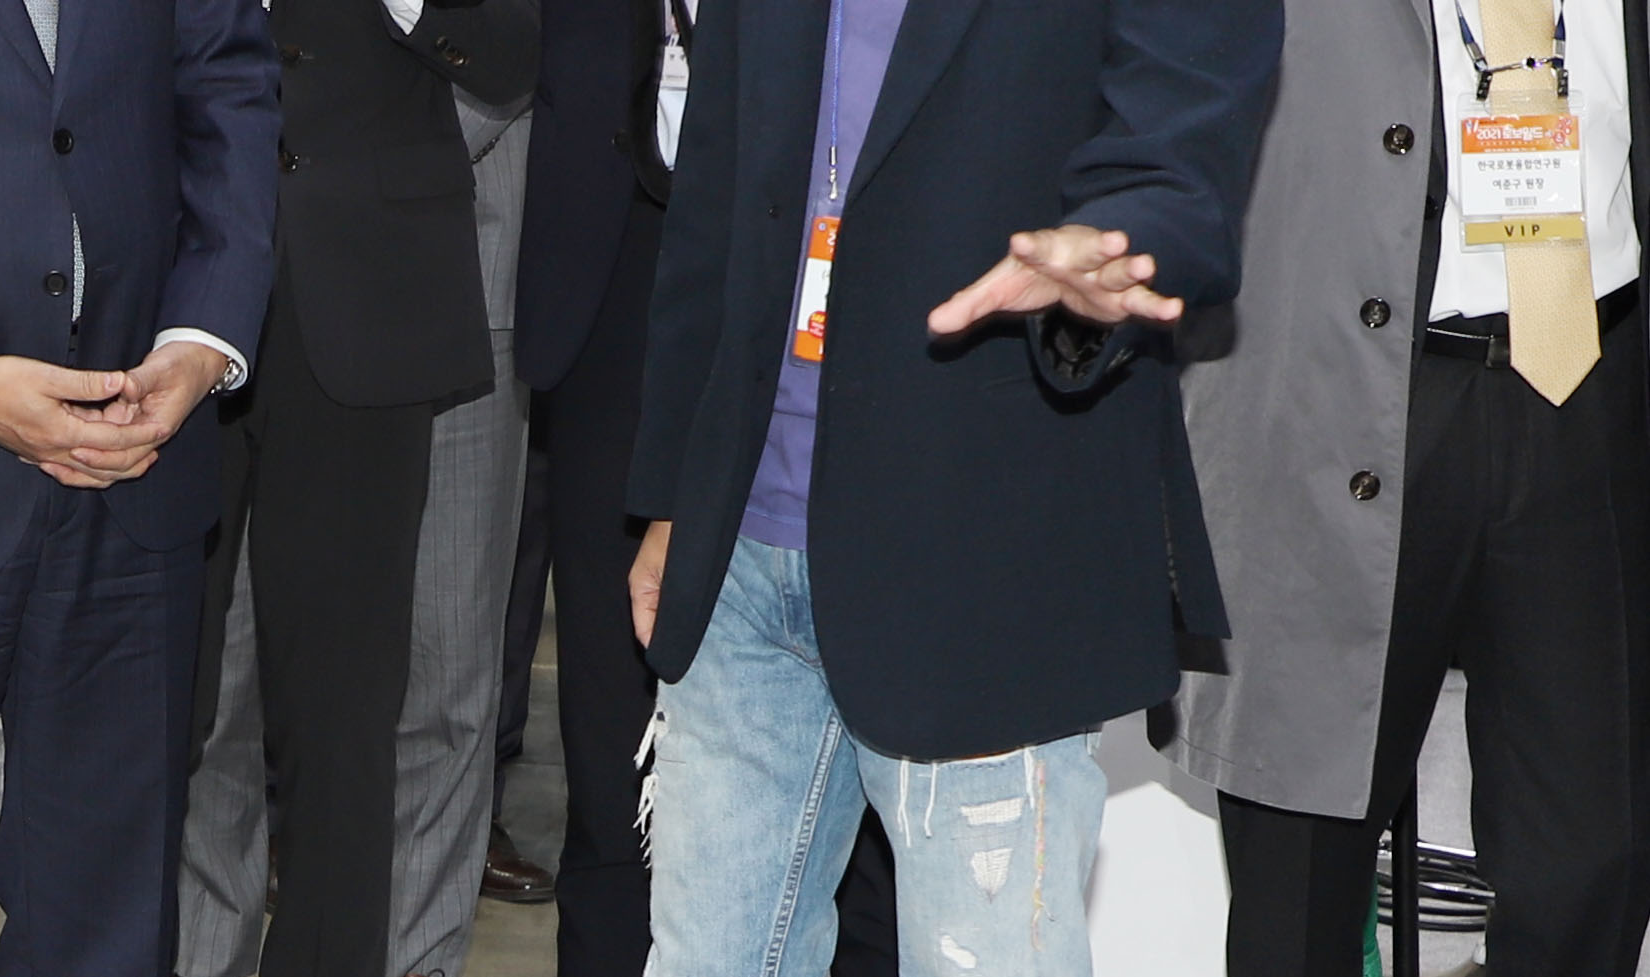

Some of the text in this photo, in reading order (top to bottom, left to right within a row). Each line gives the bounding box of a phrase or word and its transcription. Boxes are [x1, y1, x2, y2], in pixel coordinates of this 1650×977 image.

[1477, 126, 1501, 140] 2021
[1477, 157, 1561, 172] 한국로봇융합연구원
[1492, 177, 1545, 190] 여준구 원장
[1504, 224, 1540, 237] VIP
